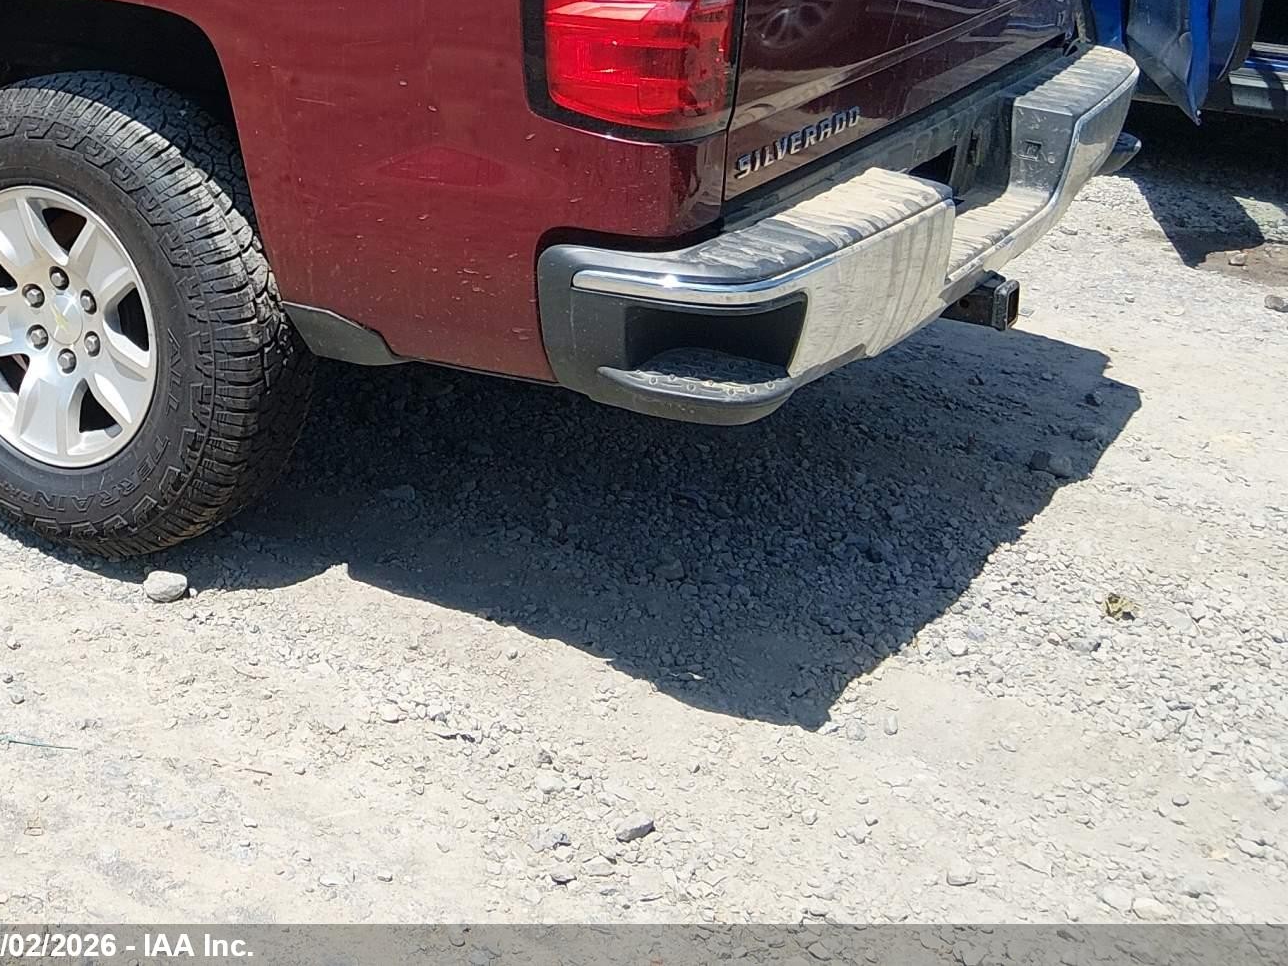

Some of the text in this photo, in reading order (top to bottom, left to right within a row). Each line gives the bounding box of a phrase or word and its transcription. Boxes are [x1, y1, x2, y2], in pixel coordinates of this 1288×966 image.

[734, 105, 861, 180] SILVERADO
[32, 327, 183, 513] ALL TERRAIN
